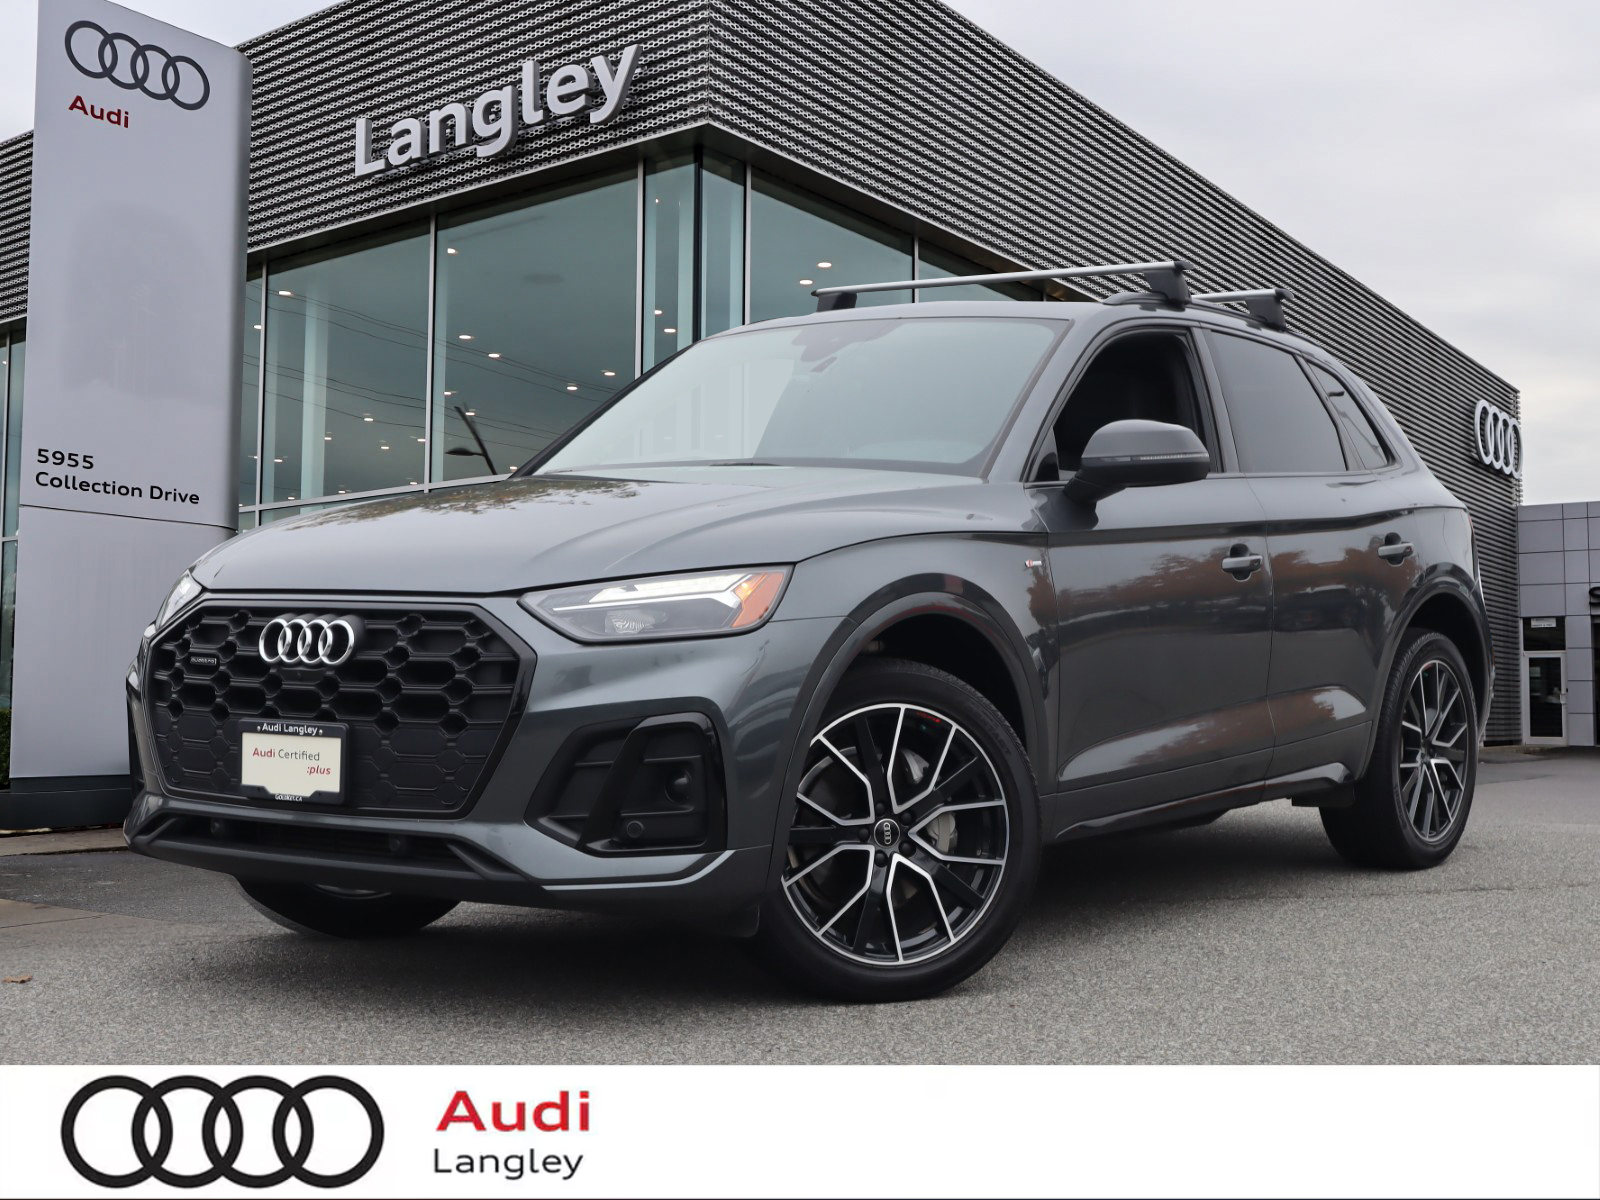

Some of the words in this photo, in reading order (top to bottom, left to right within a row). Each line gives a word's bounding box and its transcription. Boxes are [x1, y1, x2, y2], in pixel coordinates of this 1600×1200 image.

[68, 94, 129, 129] Audi
[354, 44, 643, 176] Langley
[37, 448, 94, 470] 5955
[35, 471, 143, 498] Collection
[149, 485, 200, 504] Drive
[261, 722, 282, 732] Audi
[283, 723, 318, 737] Langley
[252, 747, 276, 758] Audi
[278, 748, 320, 761] Certified
